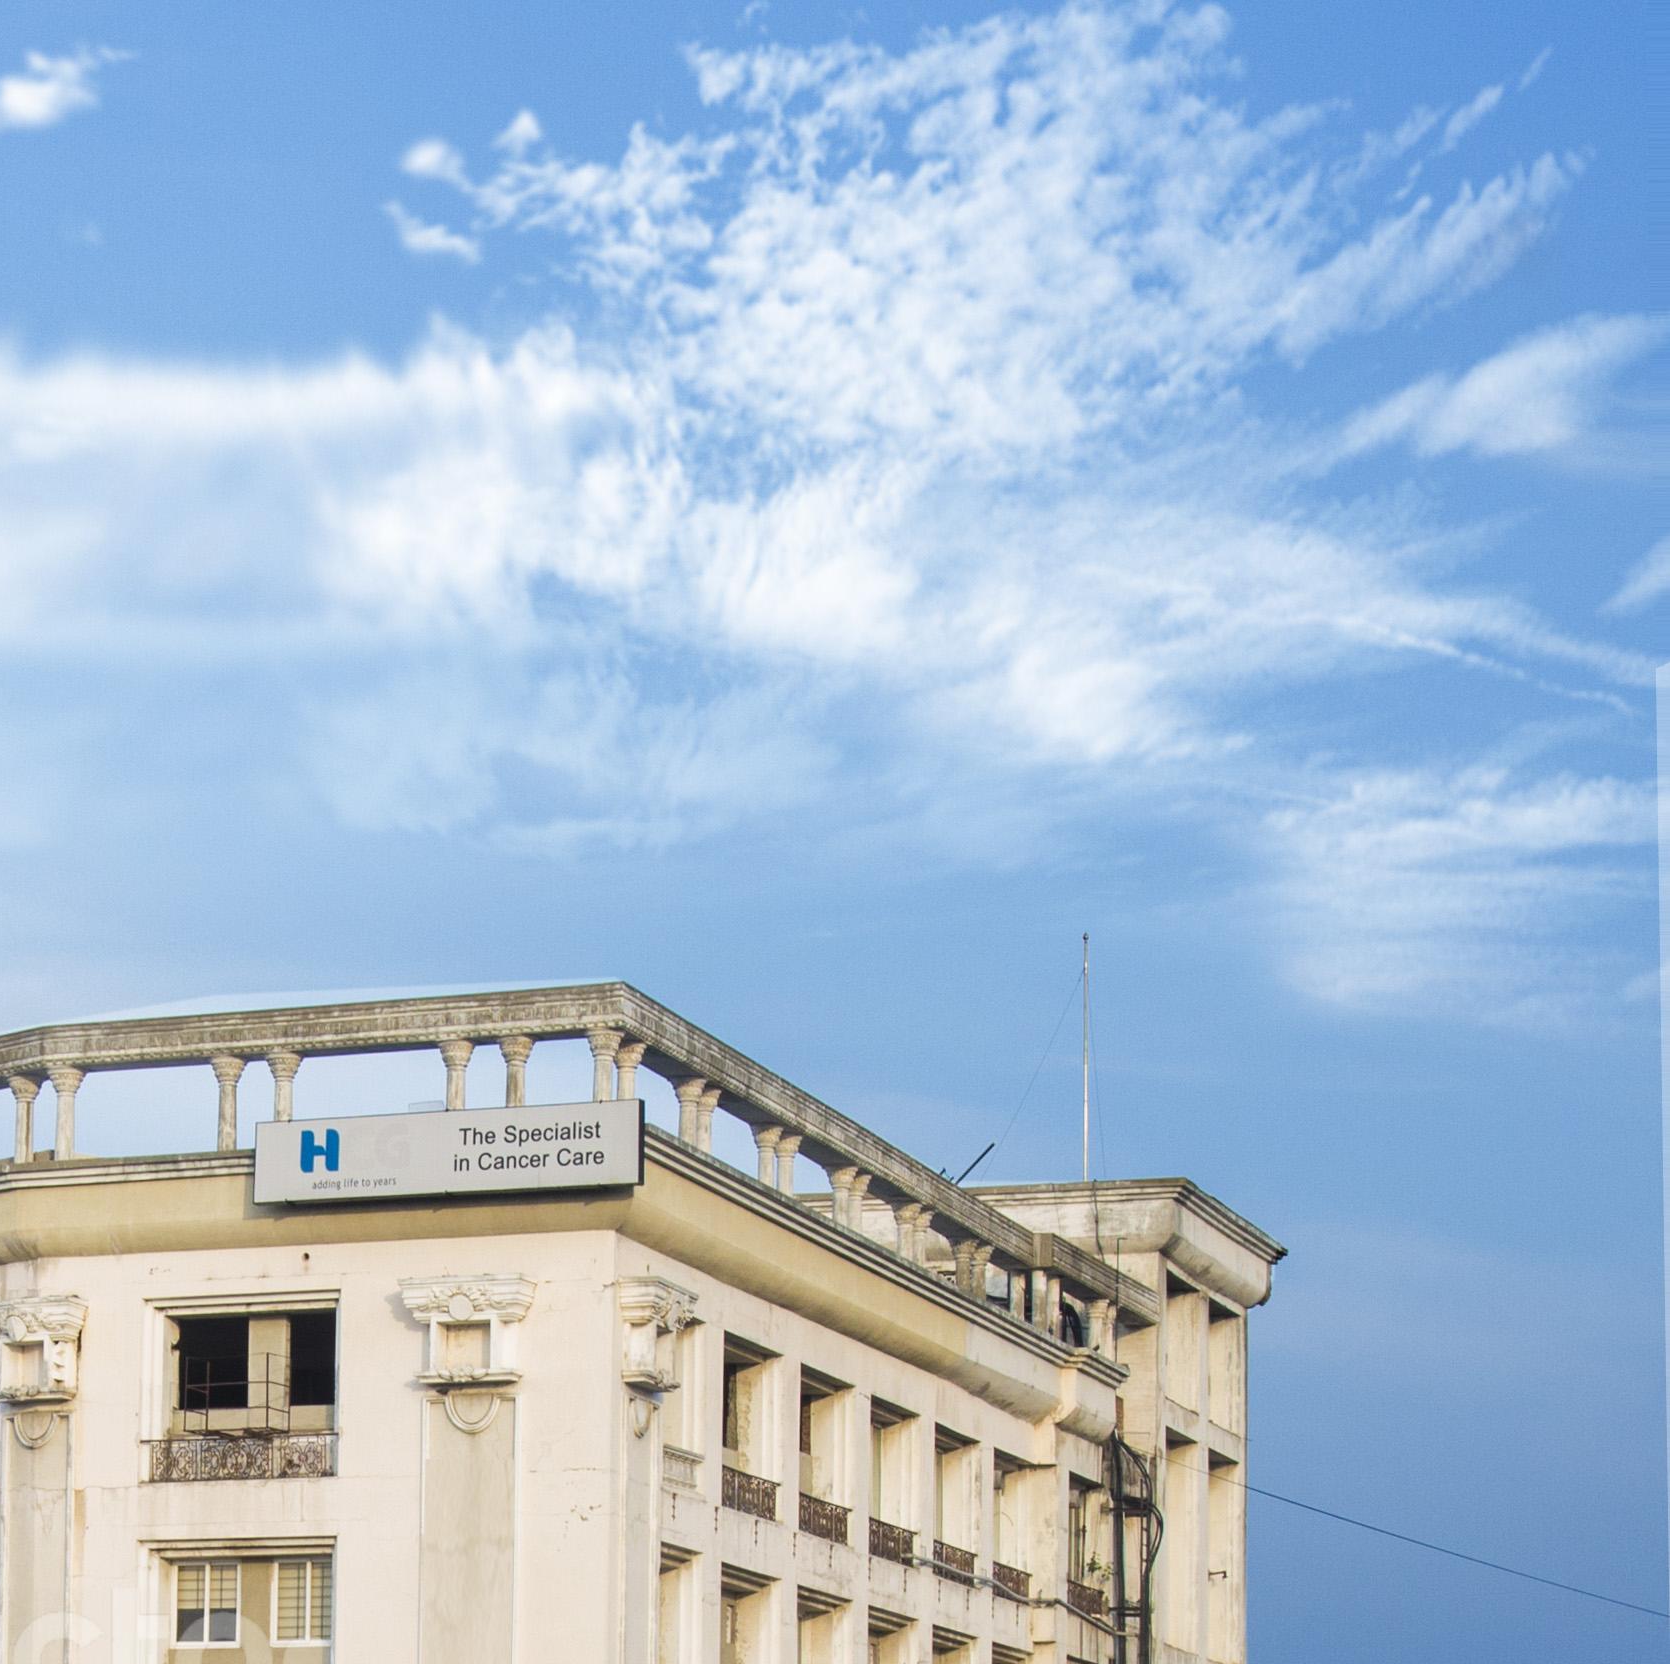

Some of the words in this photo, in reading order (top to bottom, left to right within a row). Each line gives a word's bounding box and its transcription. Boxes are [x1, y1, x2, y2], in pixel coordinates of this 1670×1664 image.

[459, 1127, 496, 1146] The
[503, 1120, 602, 1148] Specialist
[454, 1154, 470, 1172] in
[478, 1150, 550, 1172] Cancer
[556, 1148, 605, 1167] Care
[311, 1180, 342, 1191] adding
[343, 1178, 359, 1188] life
[361, 1178, 371, 1187] to
[373, 1177, 397, 1189] years
